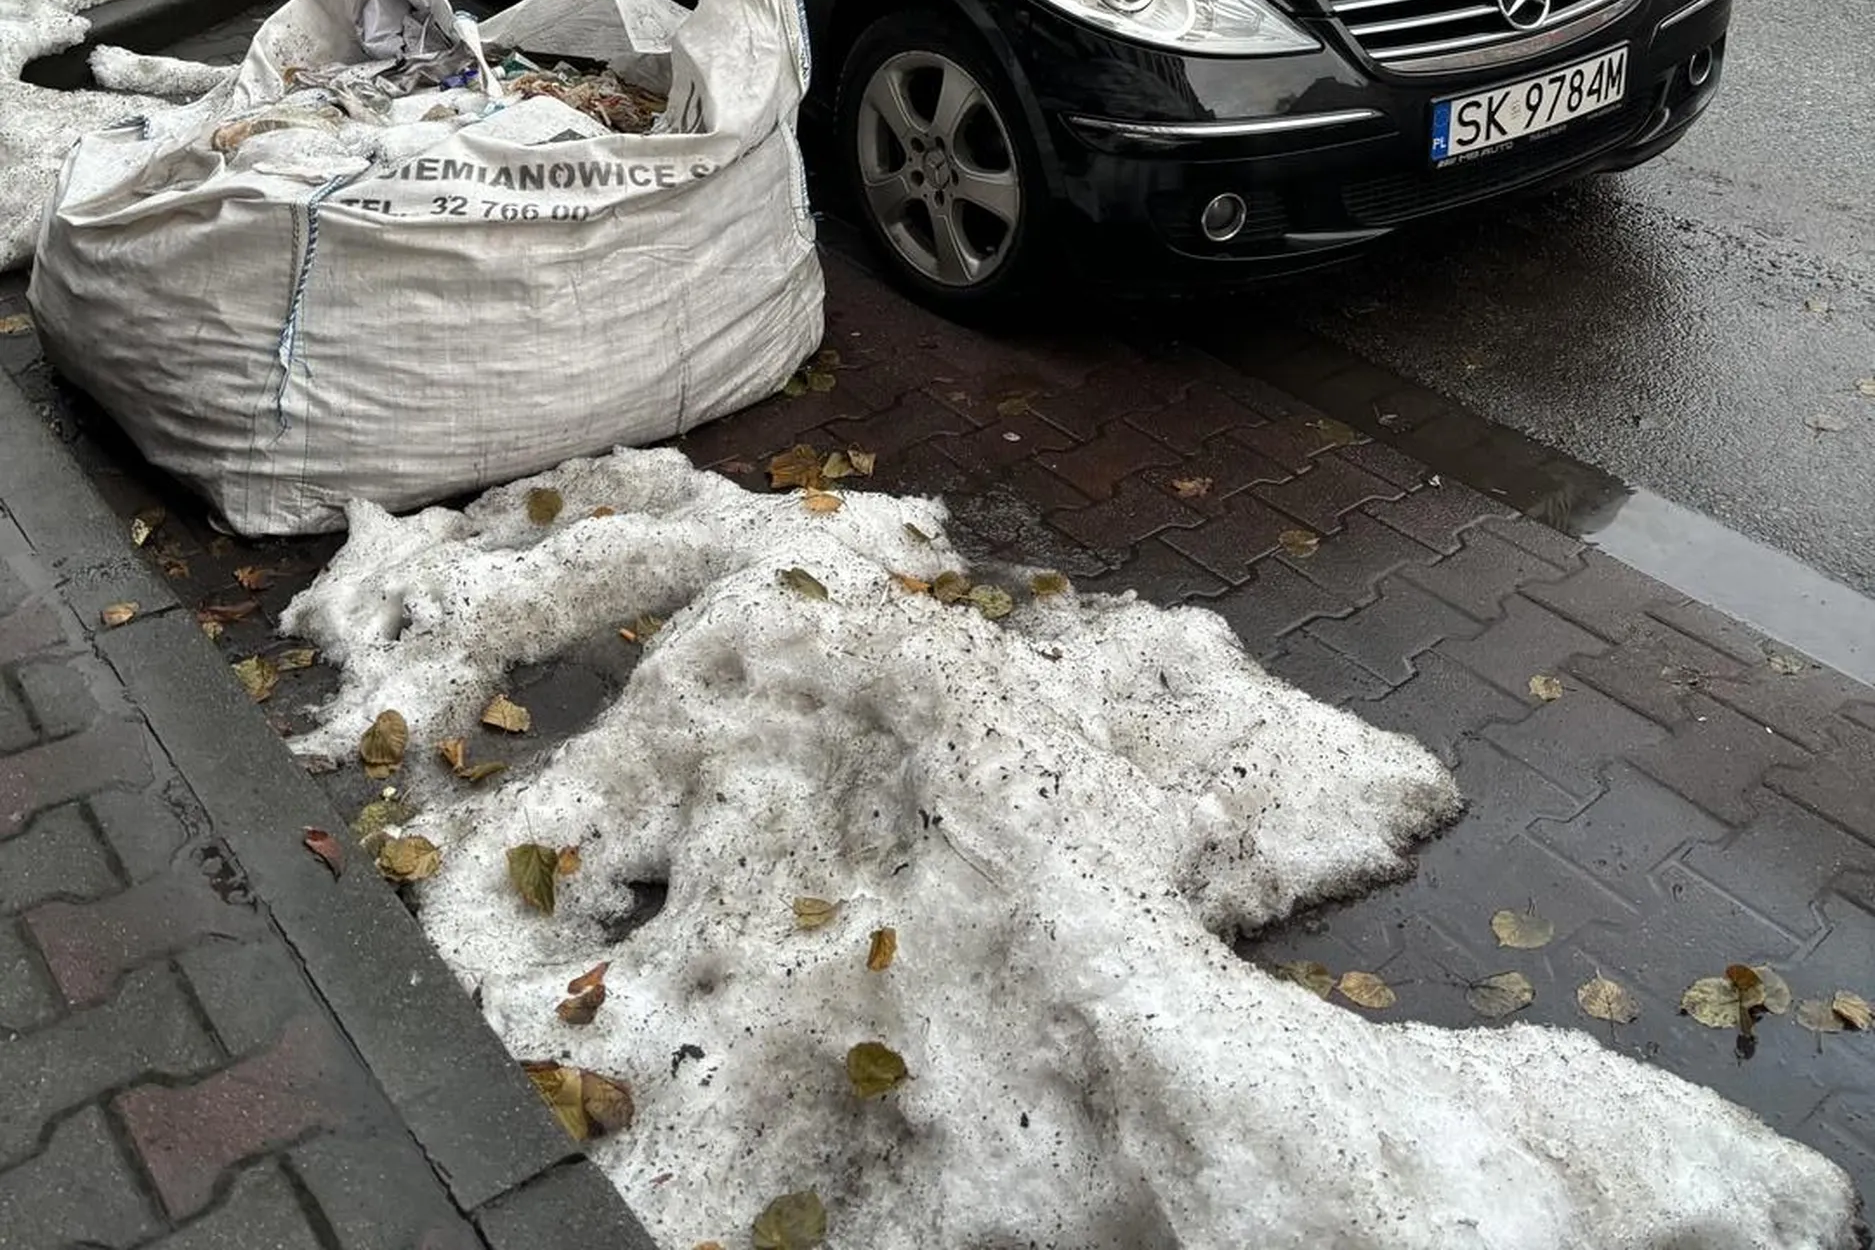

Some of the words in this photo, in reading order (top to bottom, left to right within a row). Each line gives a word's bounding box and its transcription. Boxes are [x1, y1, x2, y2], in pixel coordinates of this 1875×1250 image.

[1456, 91, 1511, 147] SK
[1525, 52, 1625, 130] 9784M
[1432, 137, 1447, 150] PL
[430, 195, 468, 217] 32
[481, 200, 540, 221] 766
[551, 204, 590, 222] 00
